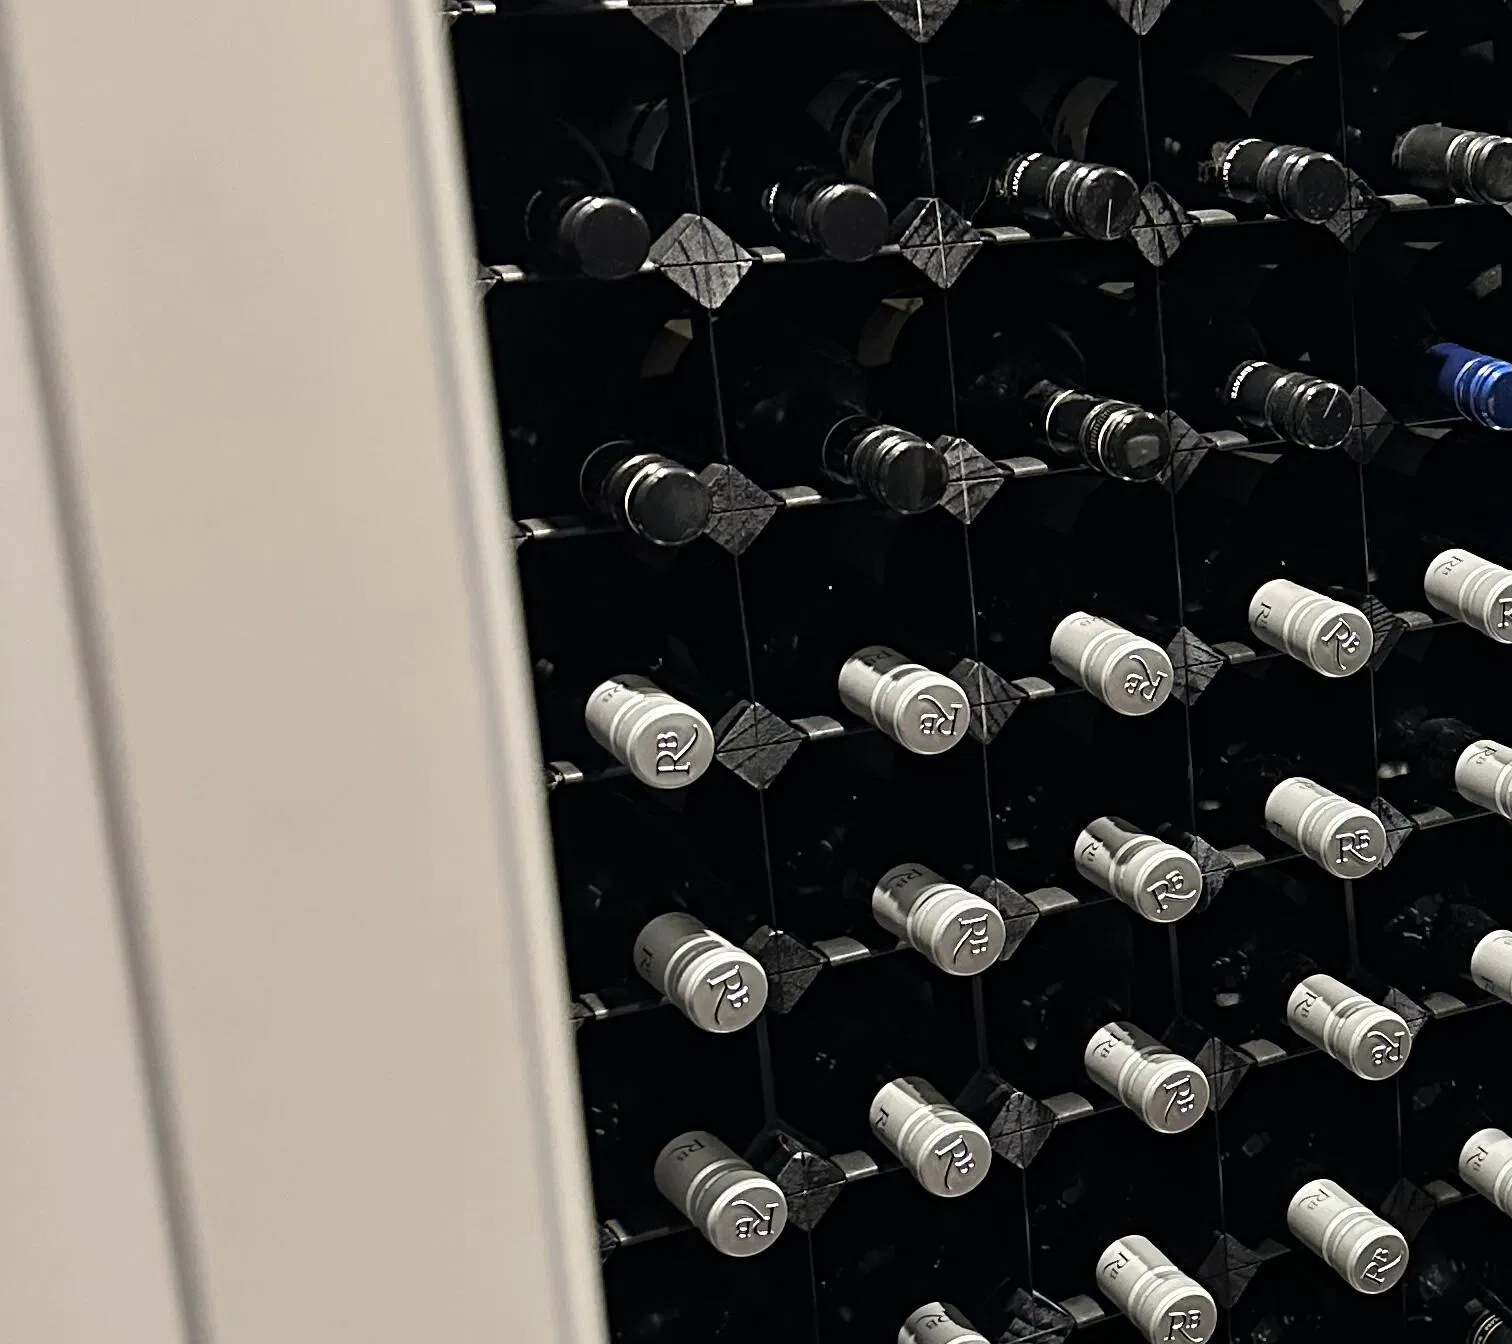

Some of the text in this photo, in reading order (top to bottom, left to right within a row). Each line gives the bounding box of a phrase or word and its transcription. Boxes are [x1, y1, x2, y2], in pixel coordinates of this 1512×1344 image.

[1320, 617, 1360, 670] RB
[1124, 654, 1169, 702] RB
[917, 694, 963, 737] RB
[657, 724, 699, 776] RB
[1335, 828, 1377, 864] RB
[1147, 869, 1197, 915] RB
[953, 912, 990, 965] RB
[706, 964, 751, 1025] RB
[1366, 1030, 1405, 1065] RB
[1162, 1074, 1196, 1125] RB
[935, 1134, 975, 1190] RB
[730, 1199, 780, 1239] RB
[1360, 1246, 1403, 1284] RB
[1163, 1309, 1204, 1343] RB
